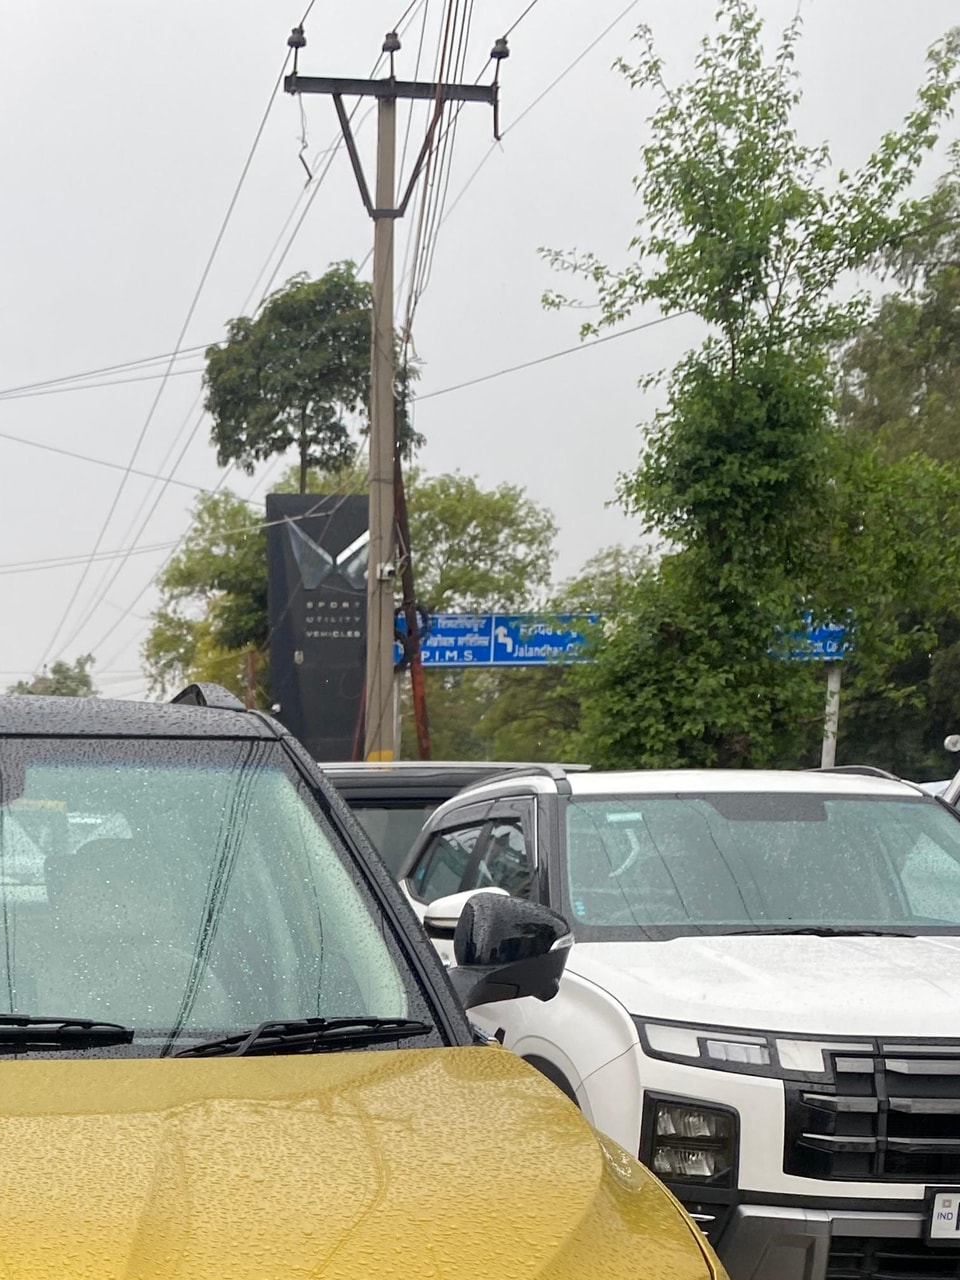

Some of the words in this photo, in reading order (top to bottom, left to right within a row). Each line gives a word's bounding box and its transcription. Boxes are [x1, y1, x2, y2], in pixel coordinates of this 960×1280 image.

[306, 601, 361, 609] SPORT
[306, 630, 361, 638] VEHICLES
[421, 650, 477, 662] P.I.M.S.
[937, 1212, 954, 1221] IND
